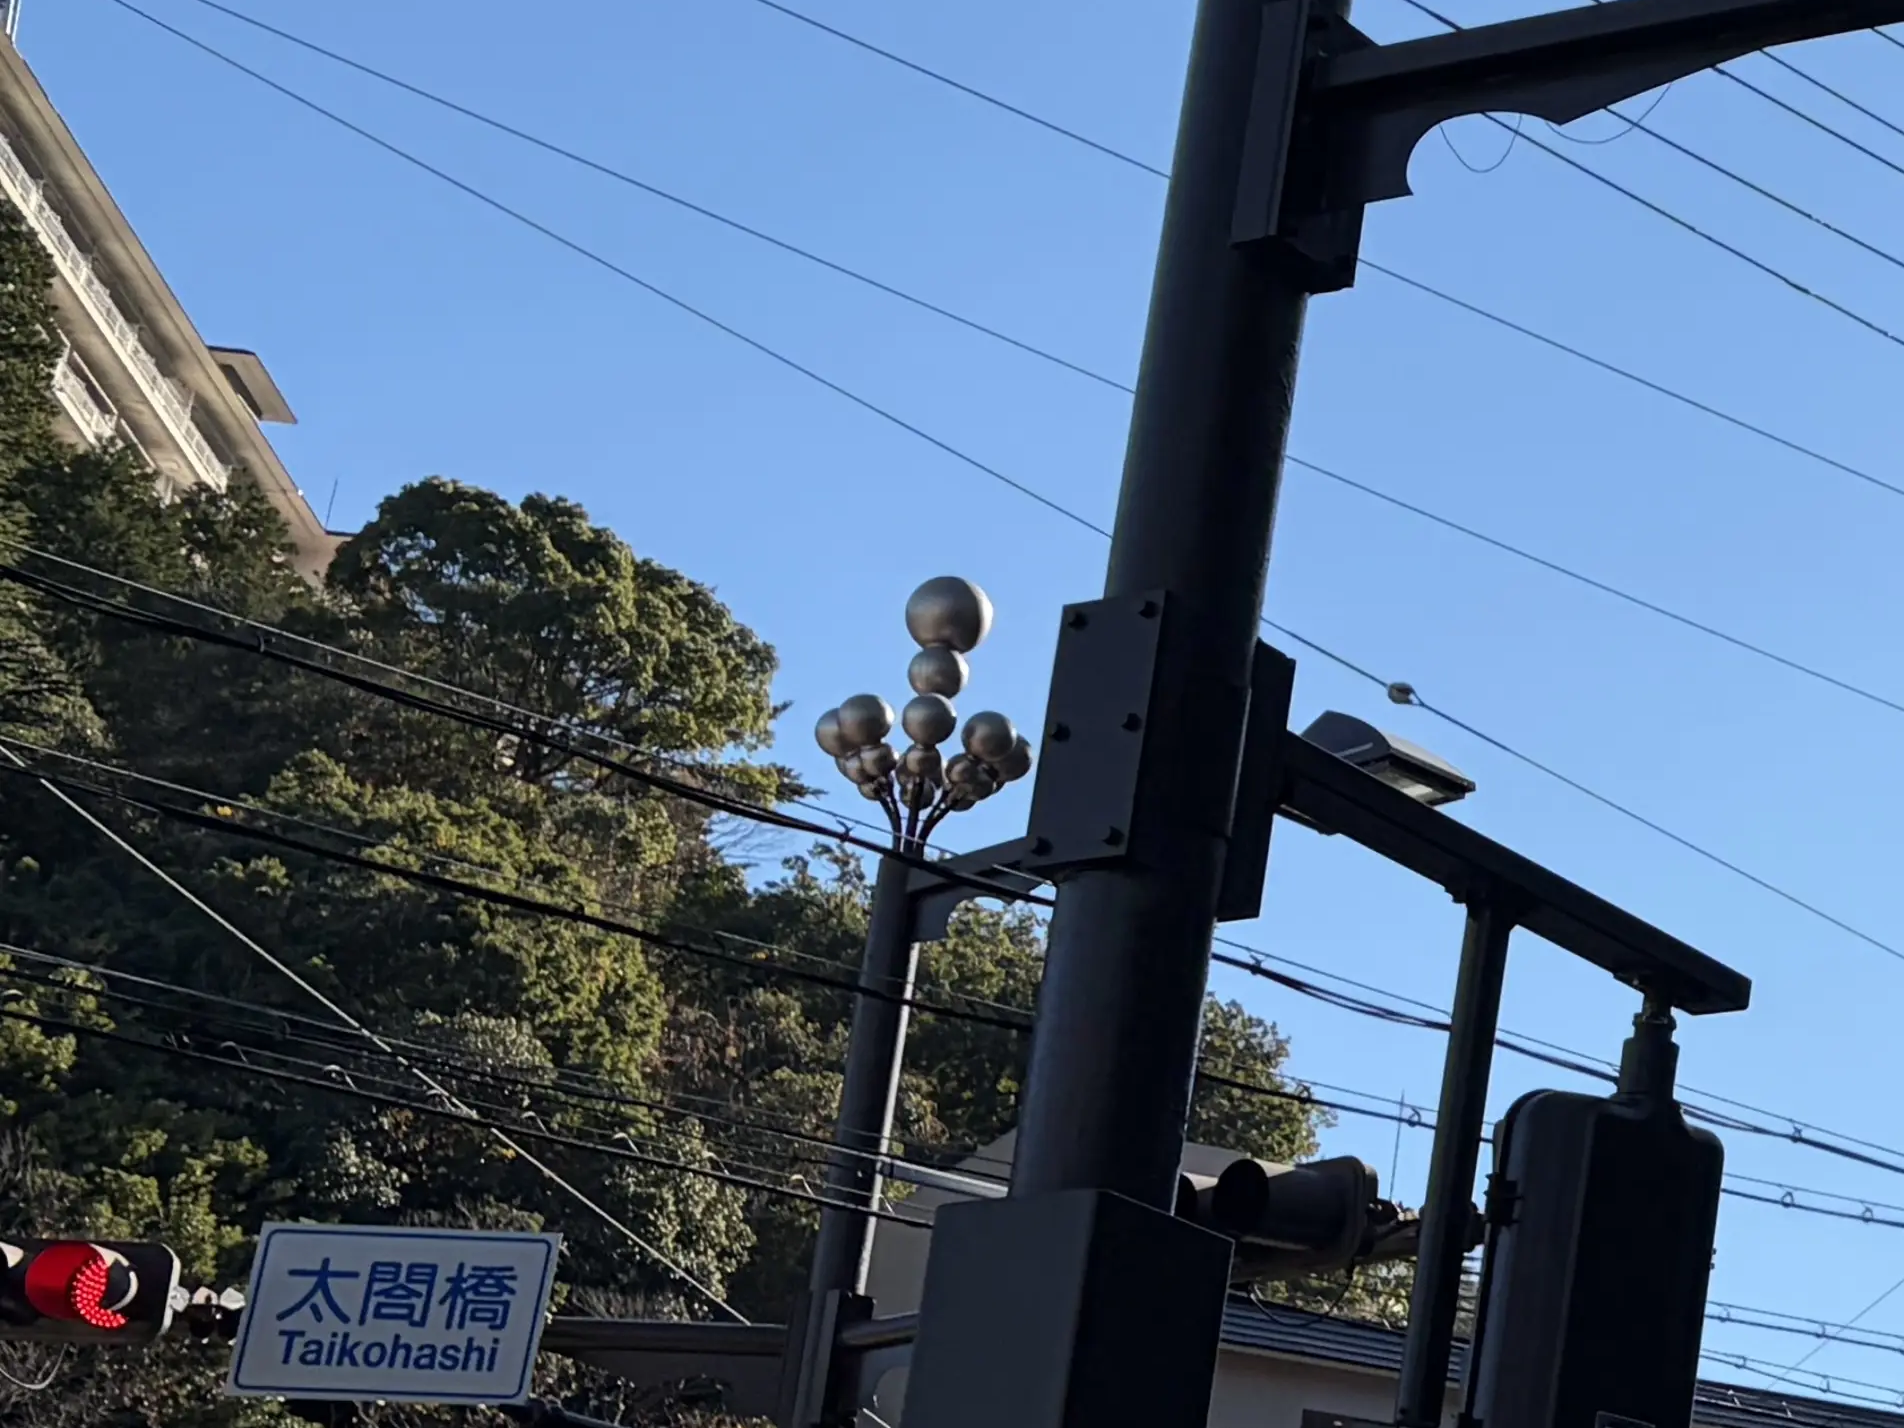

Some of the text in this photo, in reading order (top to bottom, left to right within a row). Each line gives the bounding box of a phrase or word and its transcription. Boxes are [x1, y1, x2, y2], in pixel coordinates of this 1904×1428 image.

[275, 1256, 519, 1333] 太閤橋
[279, 1329, 501, 1374] Taikohashi
